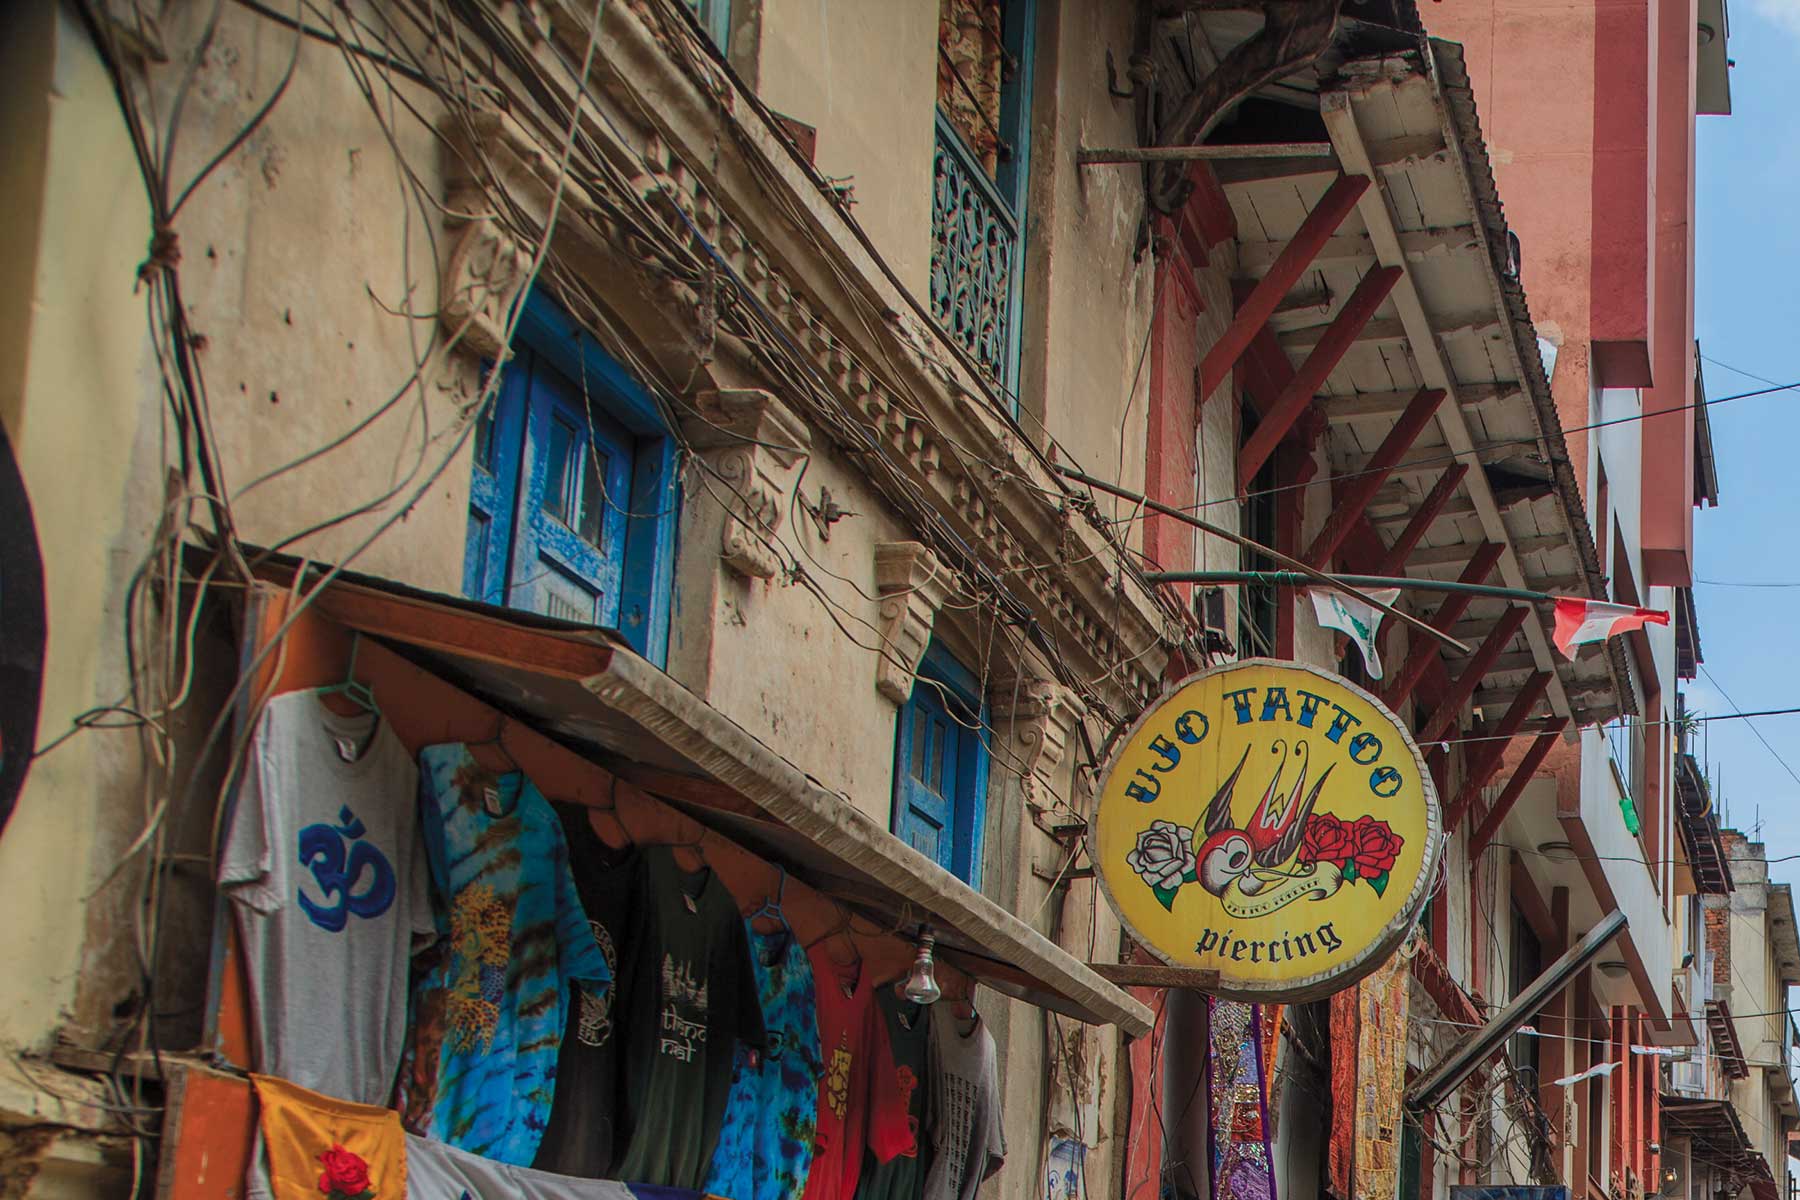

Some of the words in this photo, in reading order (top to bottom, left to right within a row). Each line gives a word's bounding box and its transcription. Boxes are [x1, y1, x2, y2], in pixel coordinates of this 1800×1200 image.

[1124, 709, 1210, 804] UJO
[1222, 686, 1403, 799] TATTOO
[1194, 919, 1344, 965] piercing
